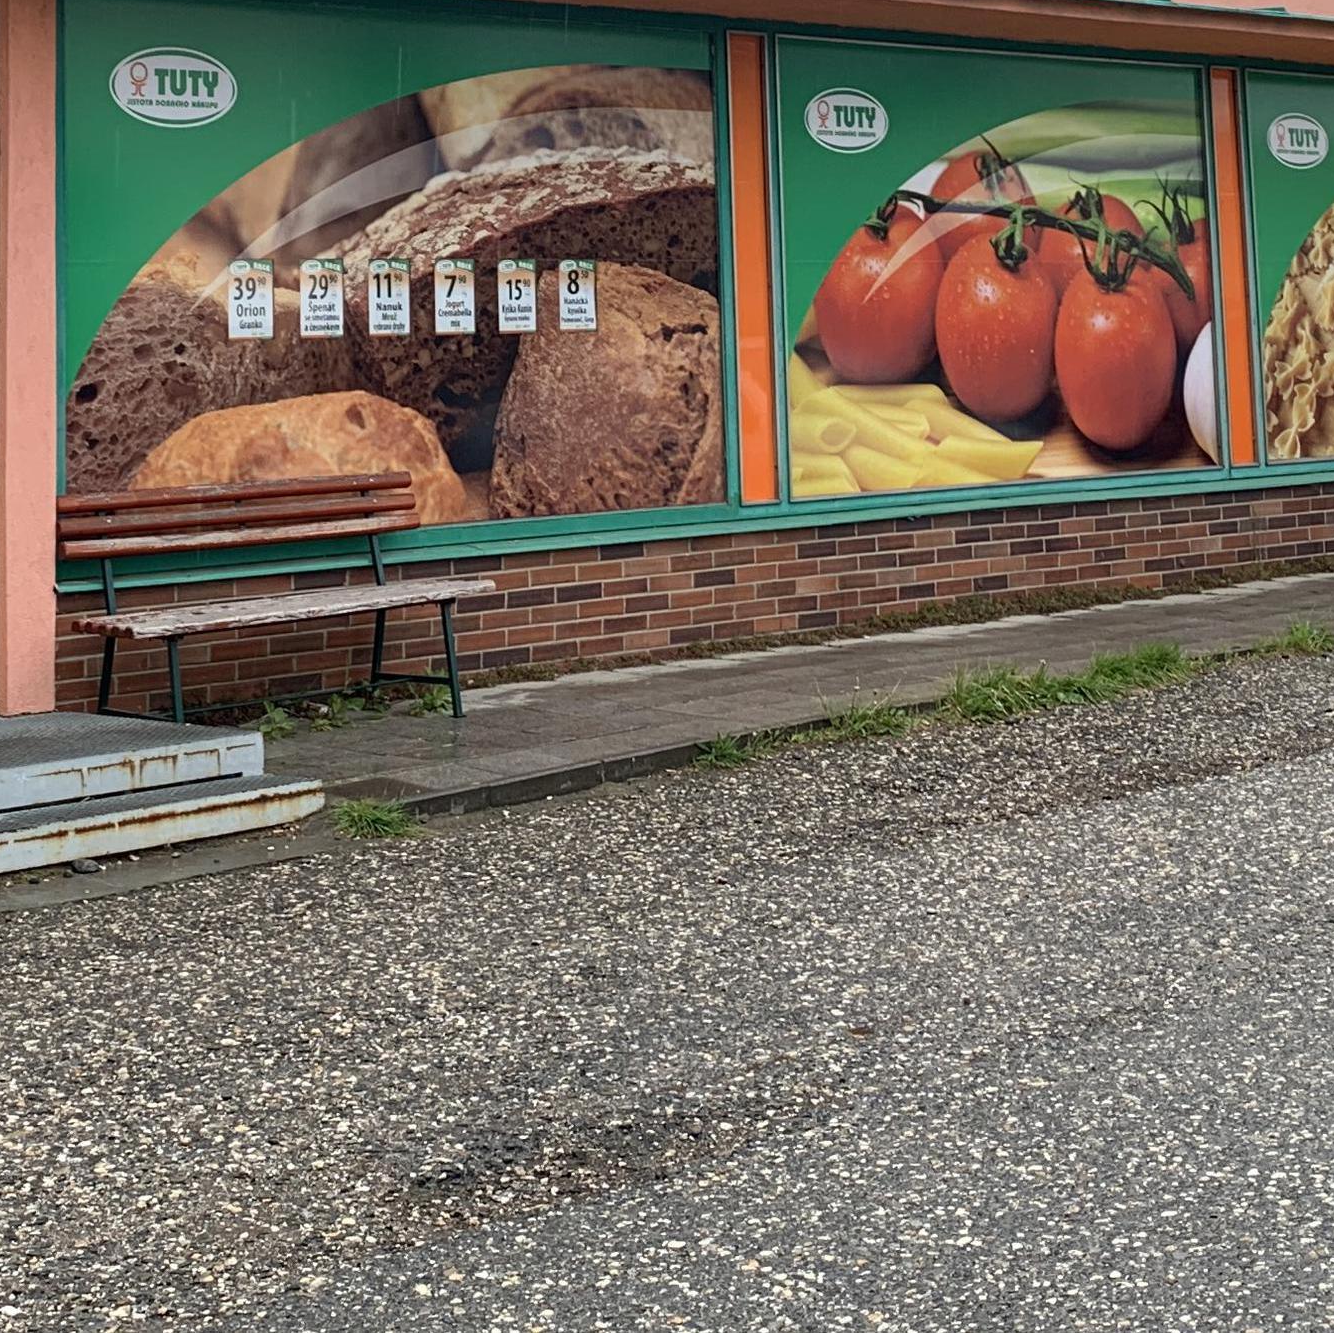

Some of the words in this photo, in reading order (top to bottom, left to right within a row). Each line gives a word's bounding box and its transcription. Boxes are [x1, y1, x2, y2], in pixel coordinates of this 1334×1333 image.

[154, 68, 219, 97] TUTY
[833, 105, 876, 128] TUTY
[1288, 128, 1318, 148] TUTY
[233, 277, 256, 301] 39
[257, 276, 266, 286] 90
[308, 274, 328, 300] 29
[373, 273, 392, 299] 11
[444, 275, 457, 298] 7
[506, 279, 522, 301] 15
[523, 279, 531, 287] 90
[567, 270, 579, 295] 8
[236, 304, 266, 317] Orion
[308, 301, 336, 314] Špenát
[375, 302, 402, 312] Nanuk
